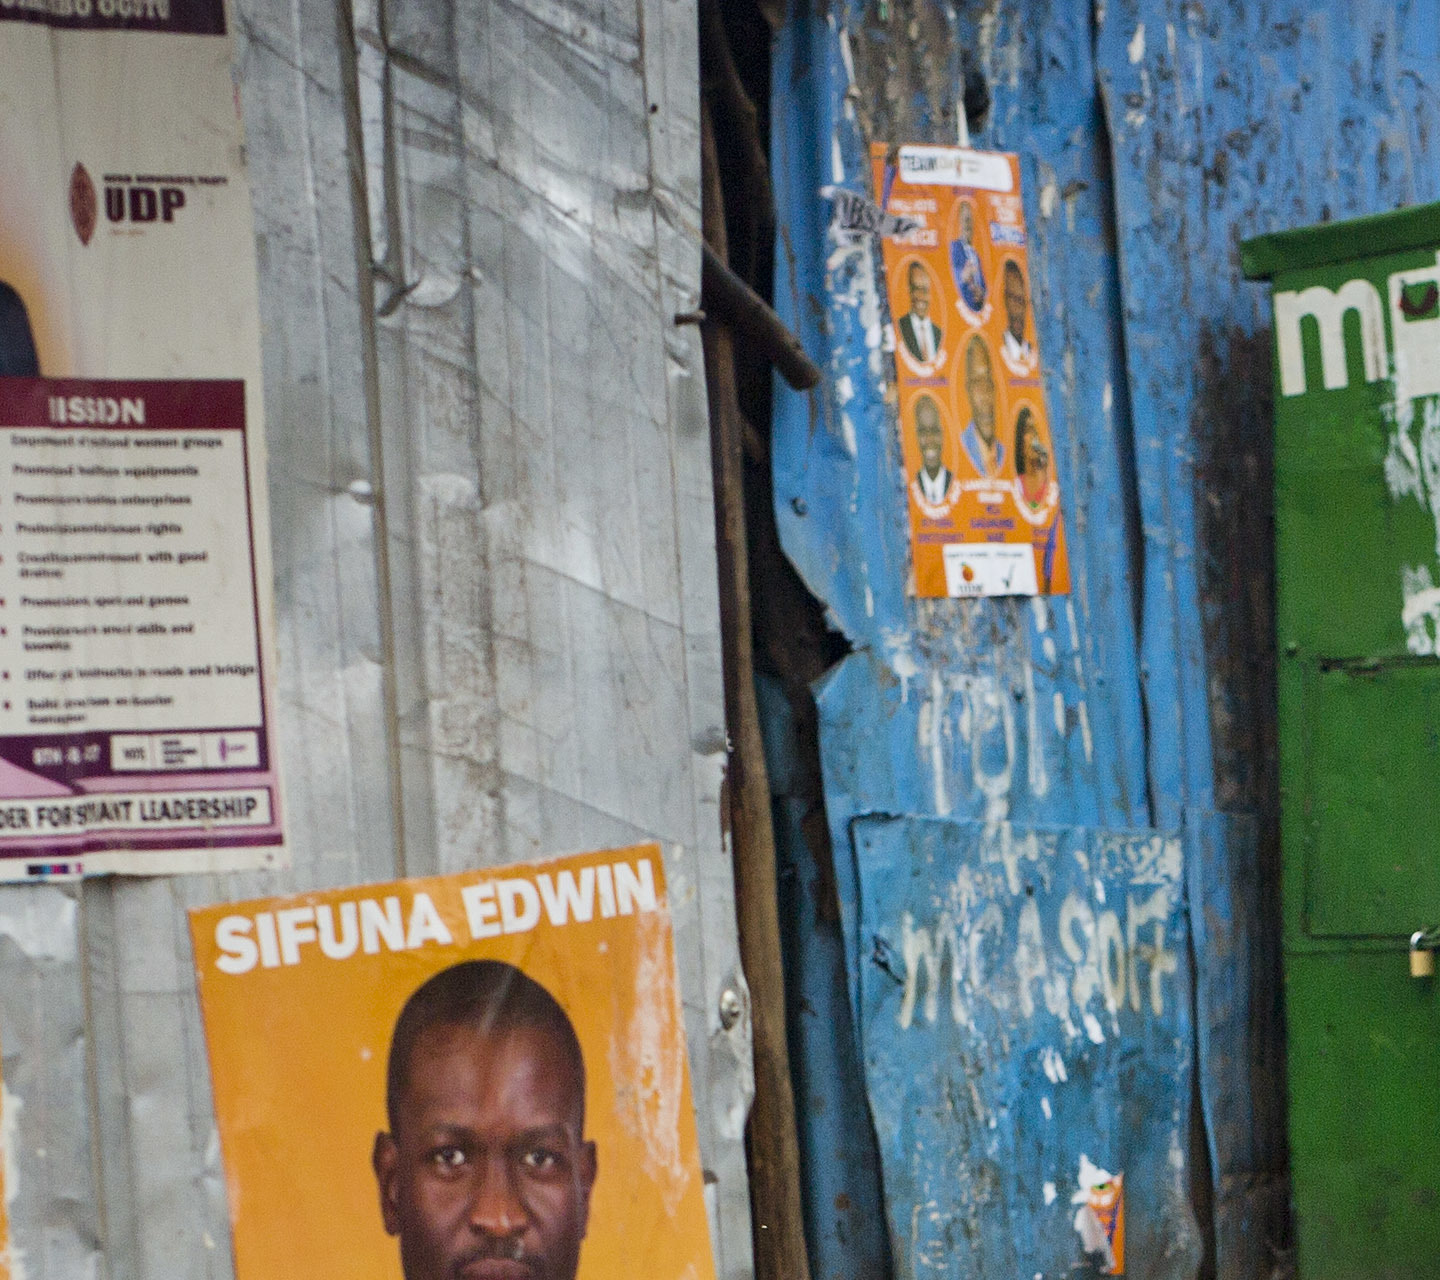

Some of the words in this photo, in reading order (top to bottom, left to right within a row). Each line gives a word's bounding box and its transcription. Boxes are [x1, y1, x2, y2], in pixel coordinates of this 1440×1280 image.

[104, 187, 187, 223] UDP
[215, 902, 454, 974] SIFUNA
[462, 858, 657, 941] EDWIN
